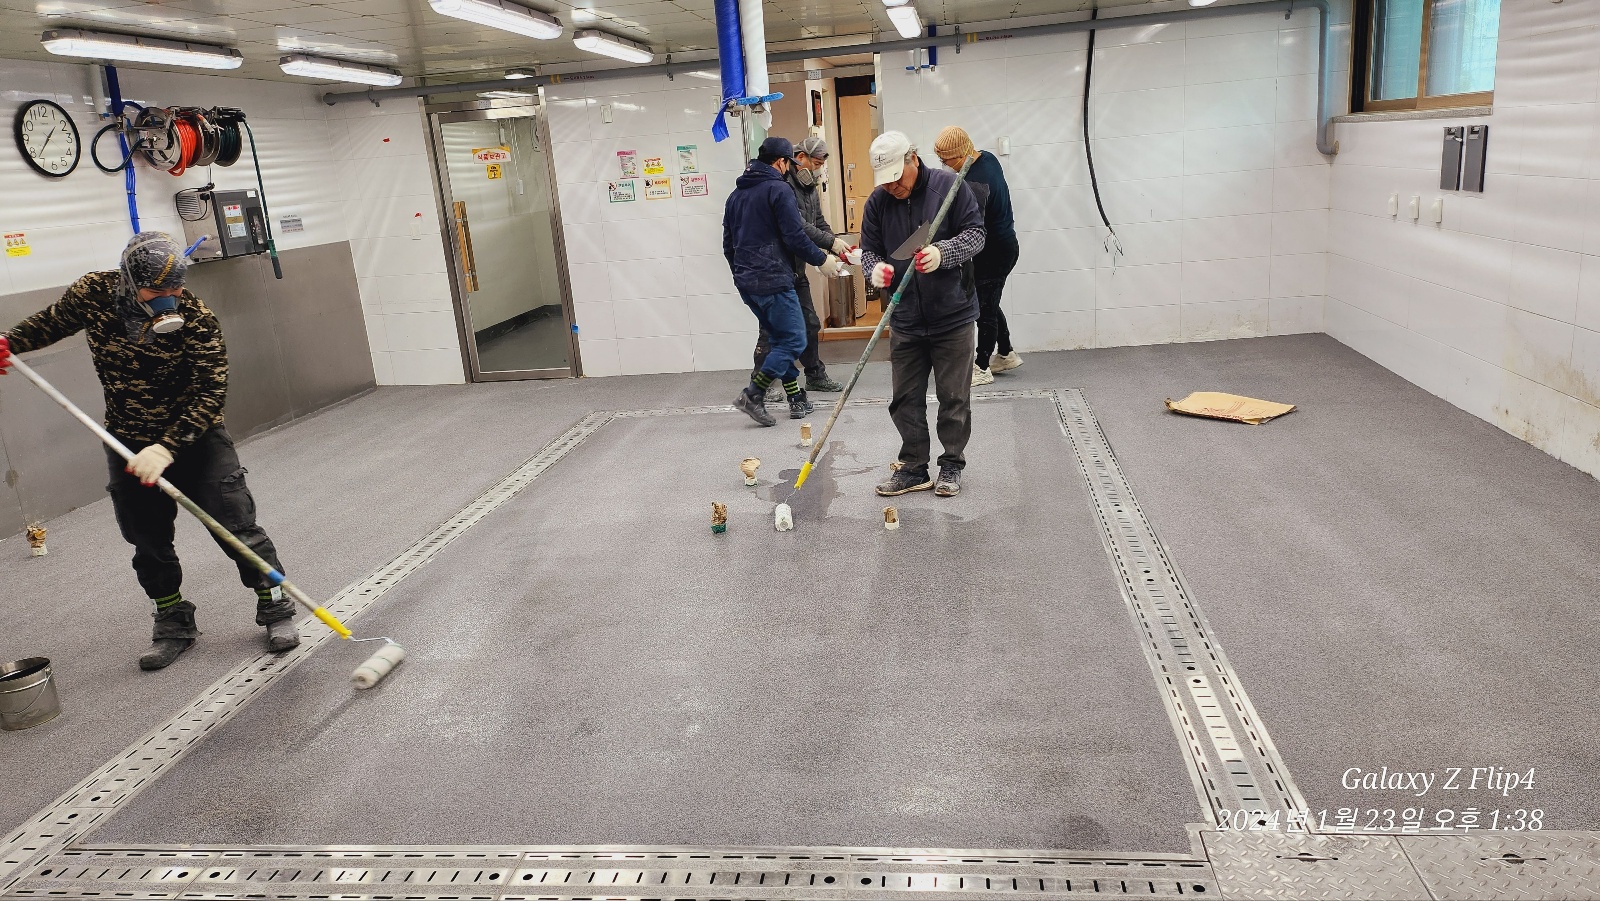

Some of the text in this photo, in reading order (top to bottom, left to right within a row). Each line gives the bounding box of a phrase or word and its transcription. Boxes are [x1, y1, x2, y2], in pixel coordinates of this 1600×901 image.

[29, 110, 37, 120] 11
[38, 106, 47, 118] 12
[52, 110, 56, 120] 1
[24, 120, 33, 131] 10
[60, 120, 68, 131] 2
[23, 134, 29, 144] 9
[66, 133, 73, 144] 3
[30, 147, 36, 158] 8
[66, 147, 72, 157] 4
[40, 157, 45, 168] 7
[51, 161, 58, 170] 6
[61, 157, 67, 167] 5
